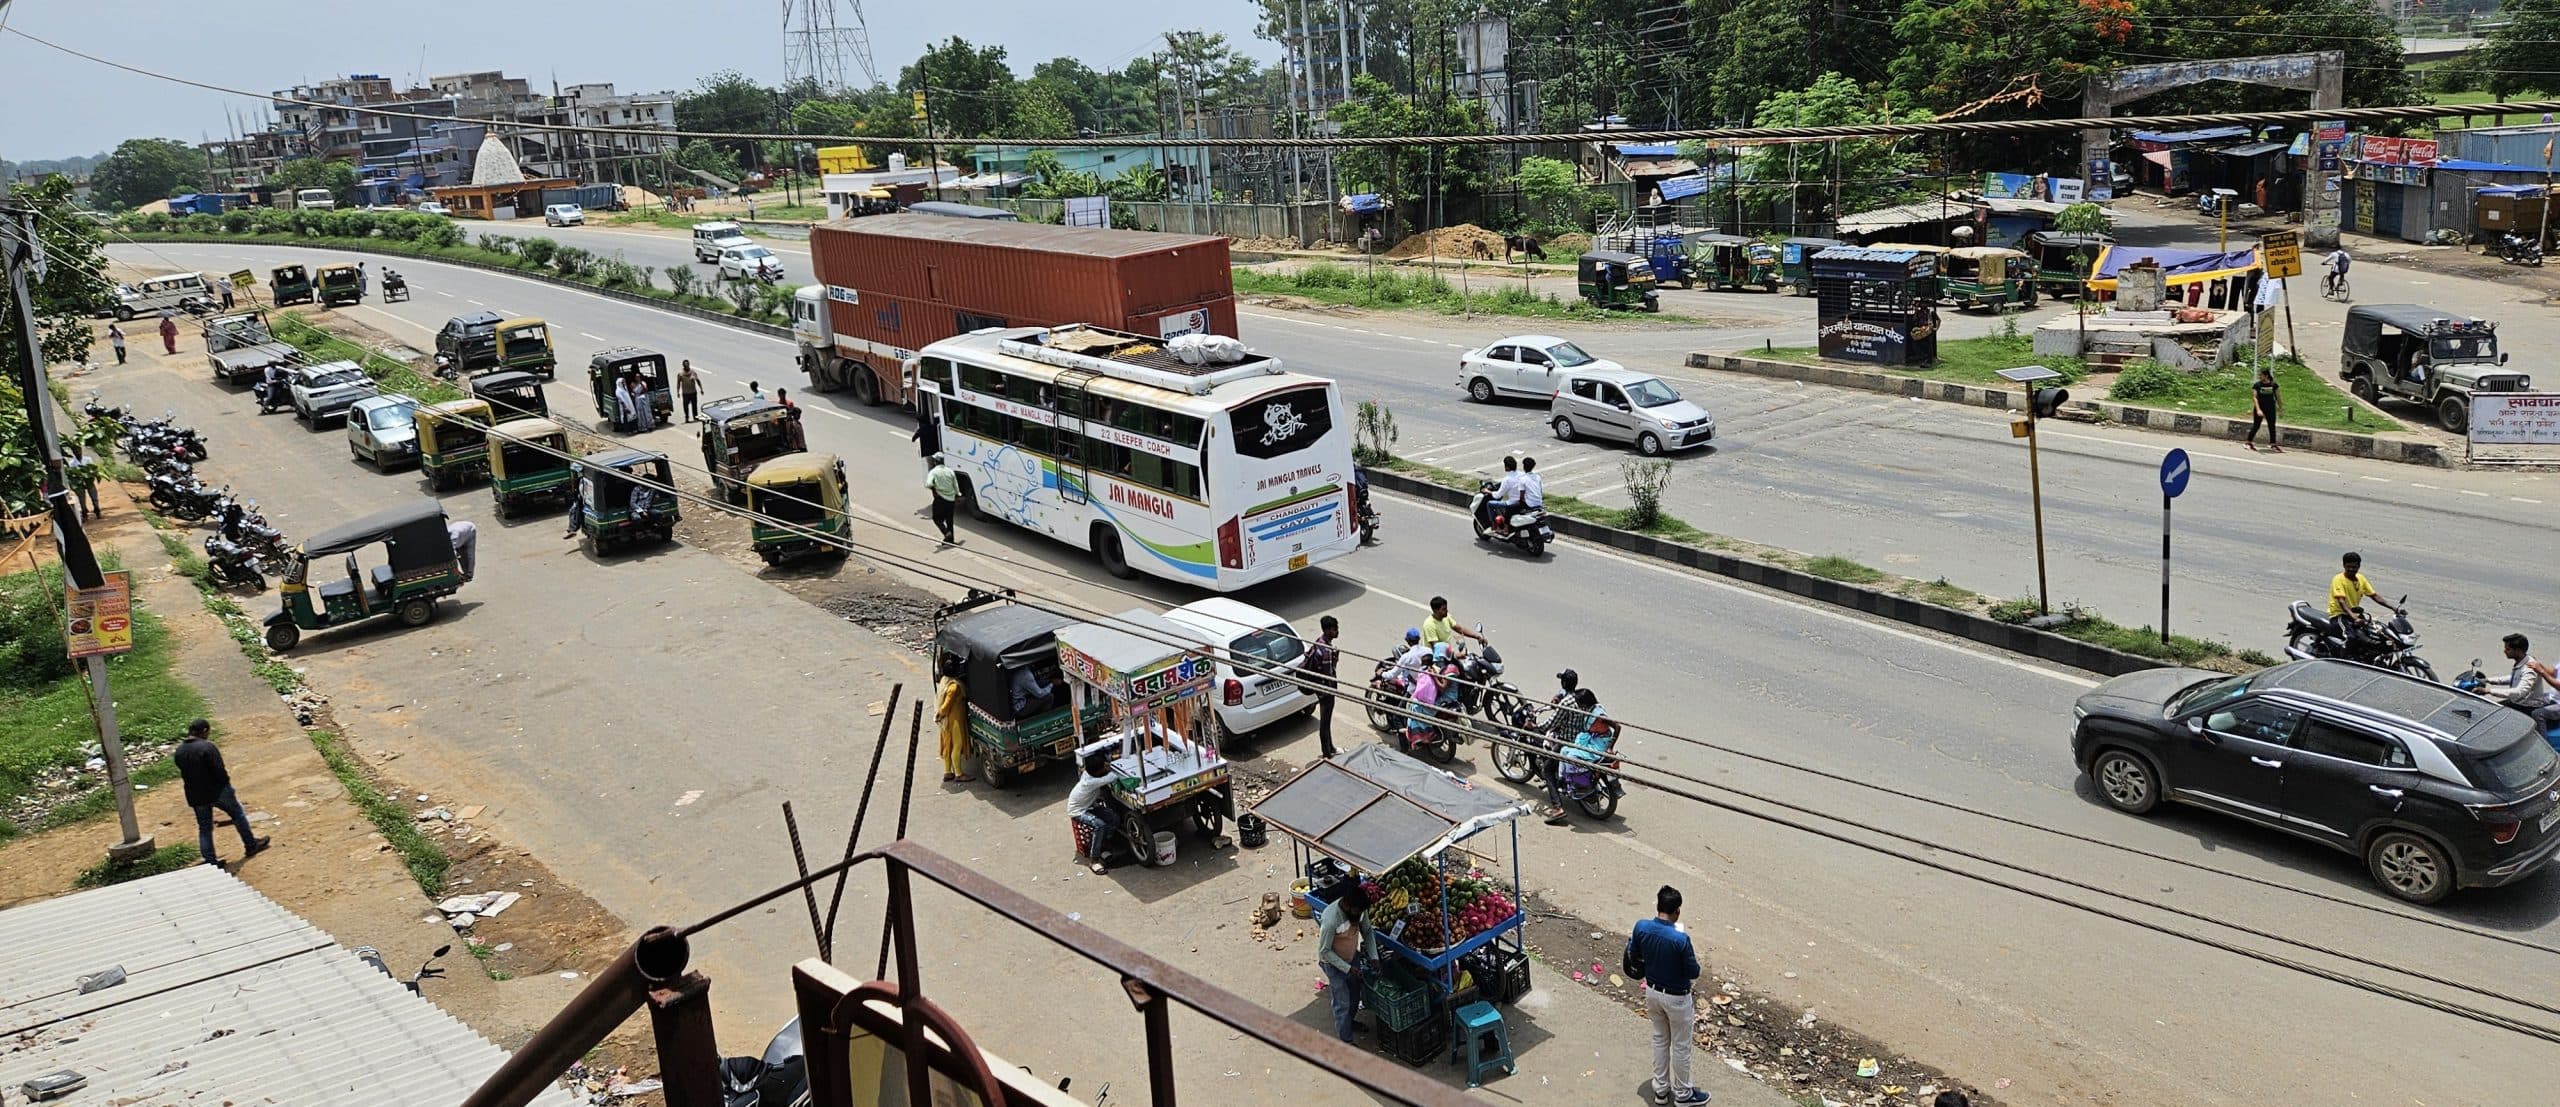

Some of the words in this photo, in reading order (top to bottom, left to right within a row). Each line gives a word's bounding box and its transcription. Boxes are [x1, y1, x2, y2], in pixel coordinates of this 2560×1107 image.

[1114, 431, 1143, 449] SLEEPER
[1147, 440, 1171, 456] COACH
[1257, 478, 1267, 492] JAI
[1268, 470, 1296, 488] MANGLA
[1296, 463, 1322, 480] TRAVELS
[1108, 483, 1125, 504] JAI
[1127, 489, 1174, 520] MANGLA
[1270, 502, 1319, 521] CHANDAUTI
[1280, 517, 1312, 531] GAYA
[1247, 537, 1256, 566] STOP
